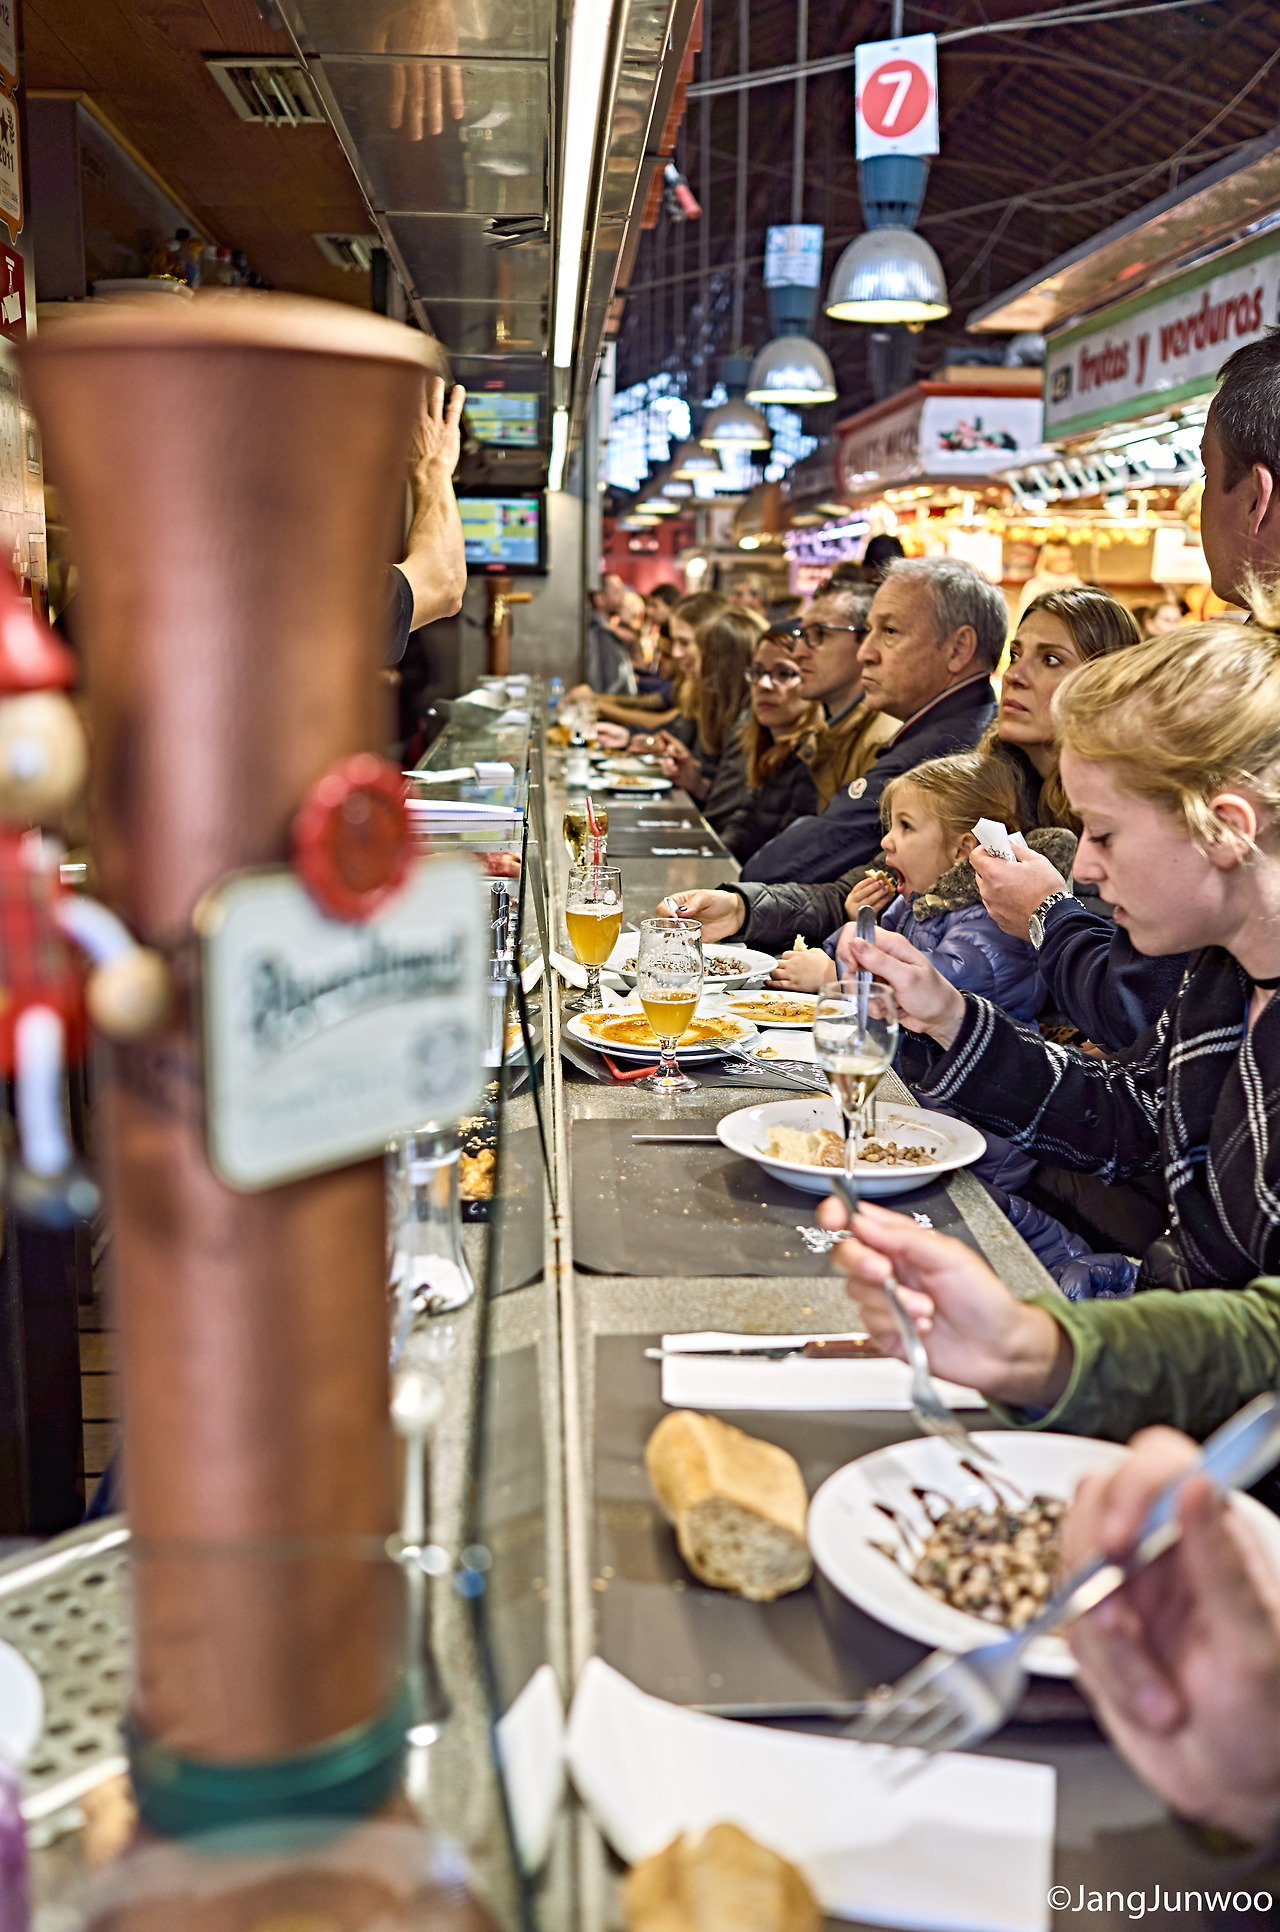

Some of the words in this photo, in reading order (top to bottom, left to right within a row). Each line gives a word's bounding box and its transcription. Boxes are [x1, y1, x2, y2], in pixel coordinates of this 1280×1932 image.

[878, 70, 912, 128] 7
[1135, 331, 1150, 386] y
[1158, 287, 1263, 363] verduras
